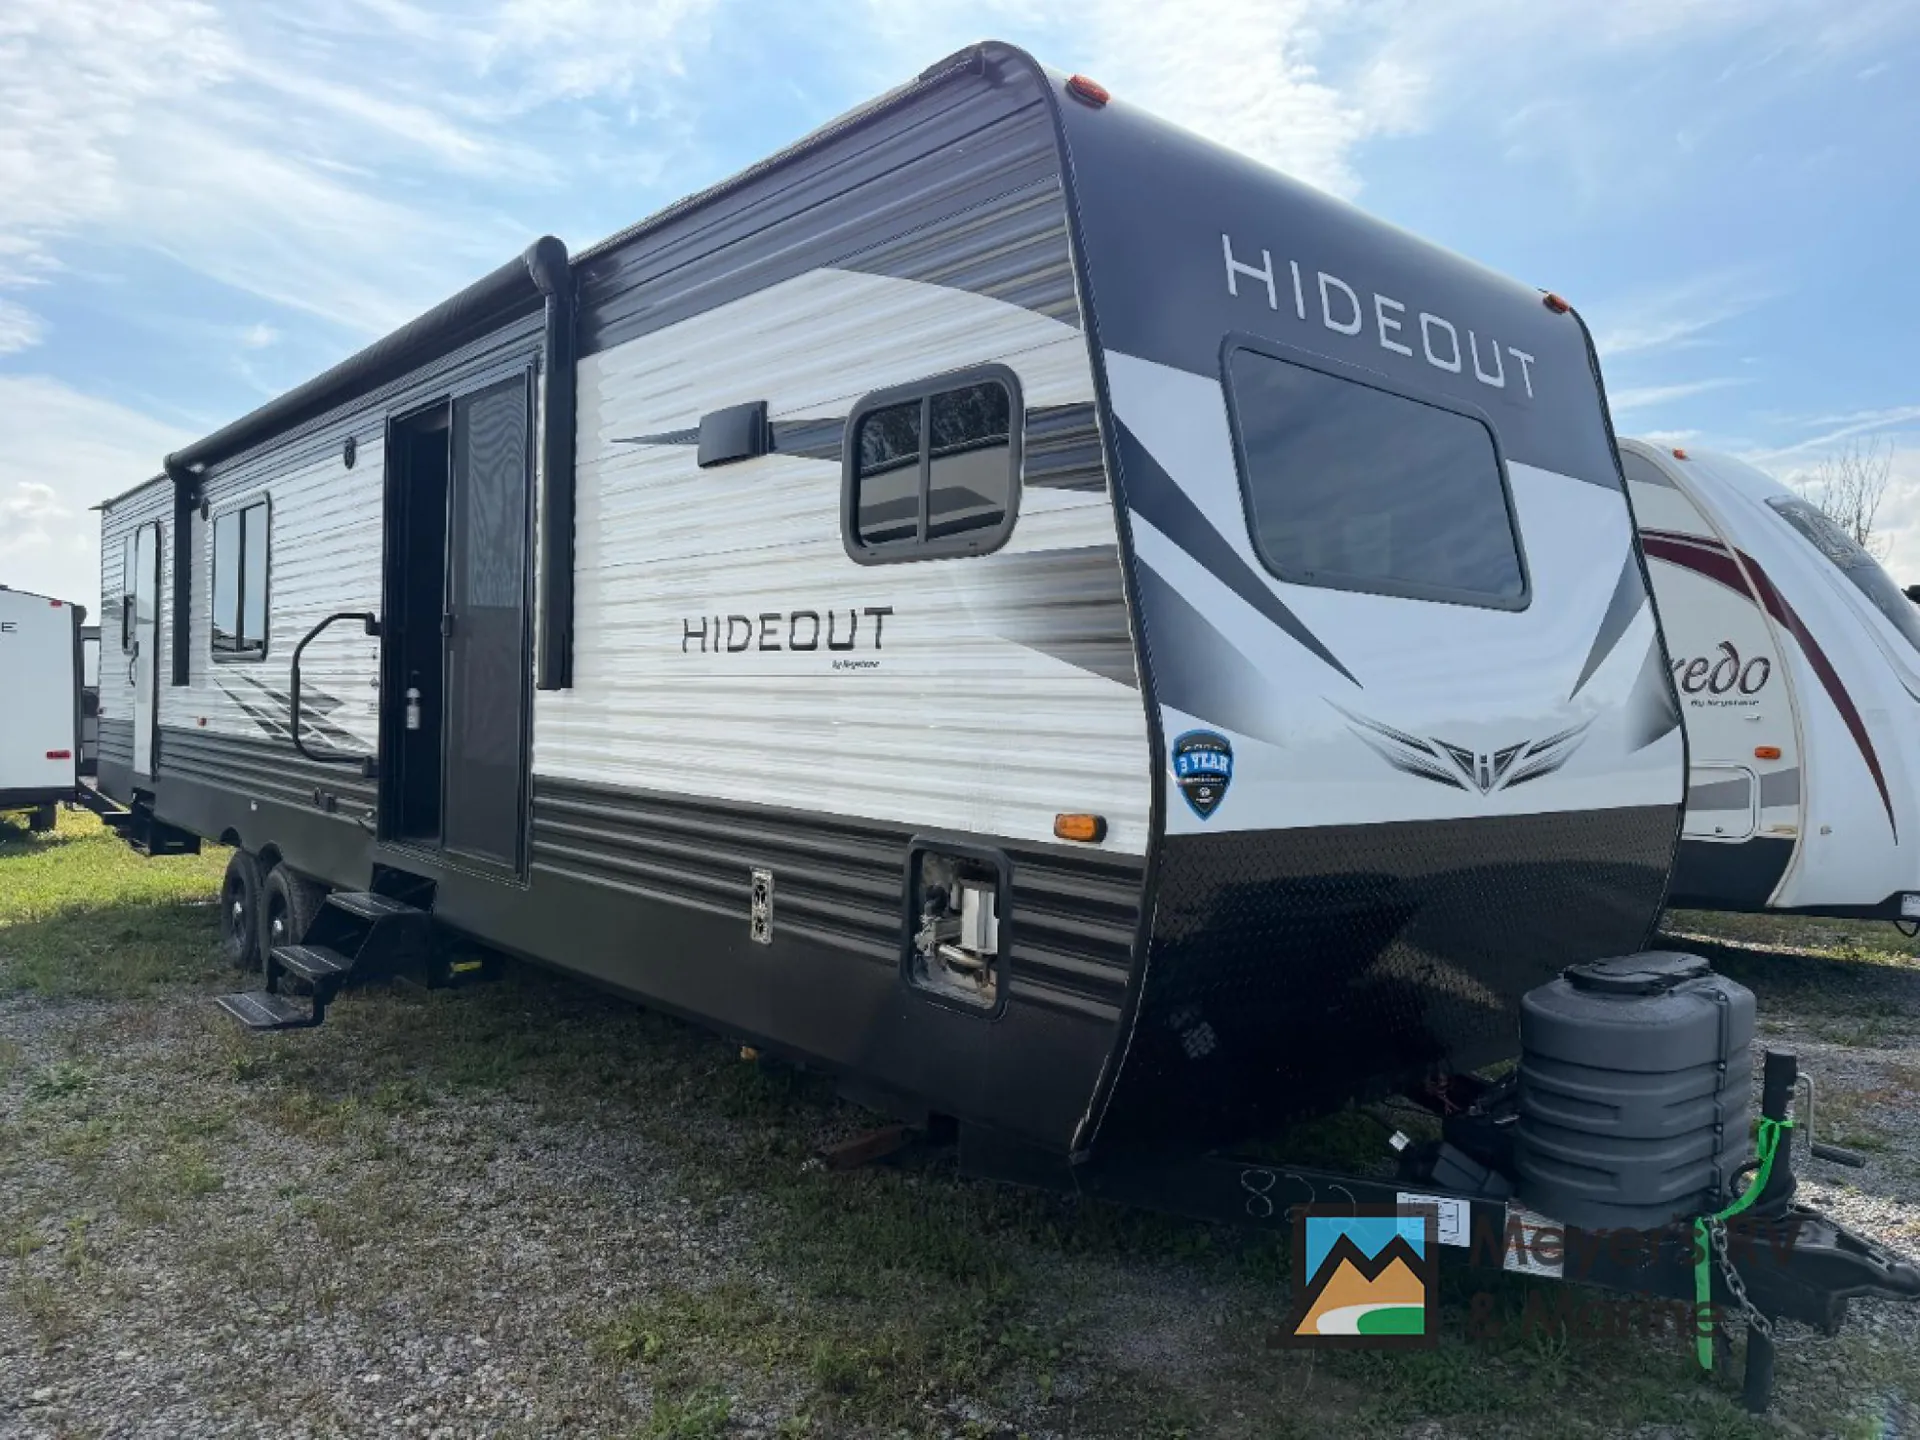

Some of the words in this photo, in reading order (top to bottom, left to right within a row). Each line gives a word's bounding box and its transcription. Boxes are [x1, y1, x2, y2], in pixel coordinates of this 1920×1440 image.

[1221, 233, 1535, 399] HIDEOUT
[682, 606, 894, 653] HIDEOUT
[1190, 752, 1229, 772] YEAR
